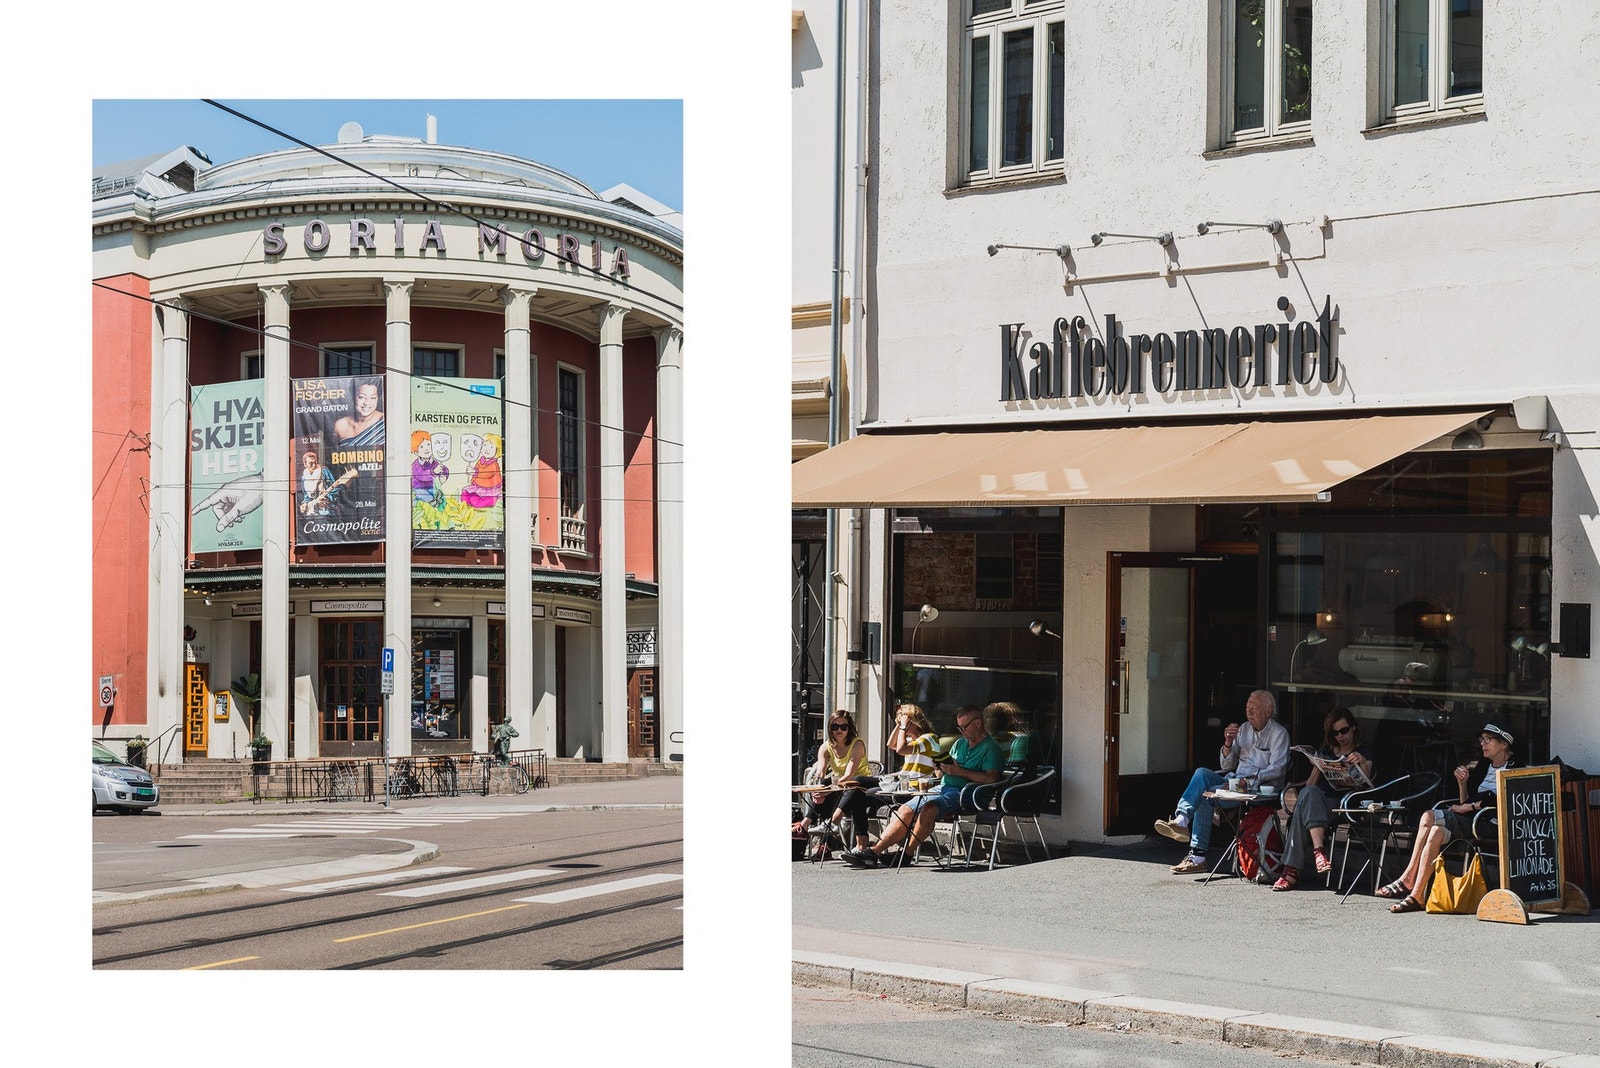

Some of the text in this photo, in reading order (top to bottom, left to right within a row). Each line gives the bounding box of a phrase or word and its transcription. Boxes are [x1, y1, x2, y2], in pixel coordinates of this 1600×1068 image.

[263, 218, 631, 278] SORIA MORIA
[999, 294, 1339, 401] Kaffebrenneriet
[295, 380, 326, 391] LISA
[295, 389, 346, 401] FISCHER
[213, 396, 264, 424] HVA
[295, 404, 349, 414] GRAND BATON
[415, 413, 455, 424] KARSTEN
[457, 415, 469, 424] OG
[471, 415, 499, 425] PETRA
[202, 448, 258, 476] HER
[331, 450, 384, 465] BOMBINO
[303, 516, 381, 535] Cosmopolite
[324, 601, 369, 611] Cosmopolite
[384, 651, 392, 669] P
[1512, 792, 1555, 816] ISKAFFE
[1511, 818, 1555, 839] ISMOCCA
[1523, 839, 1547, 857] ISTE
[1510, 857, 1555, 878] LIMONADE
